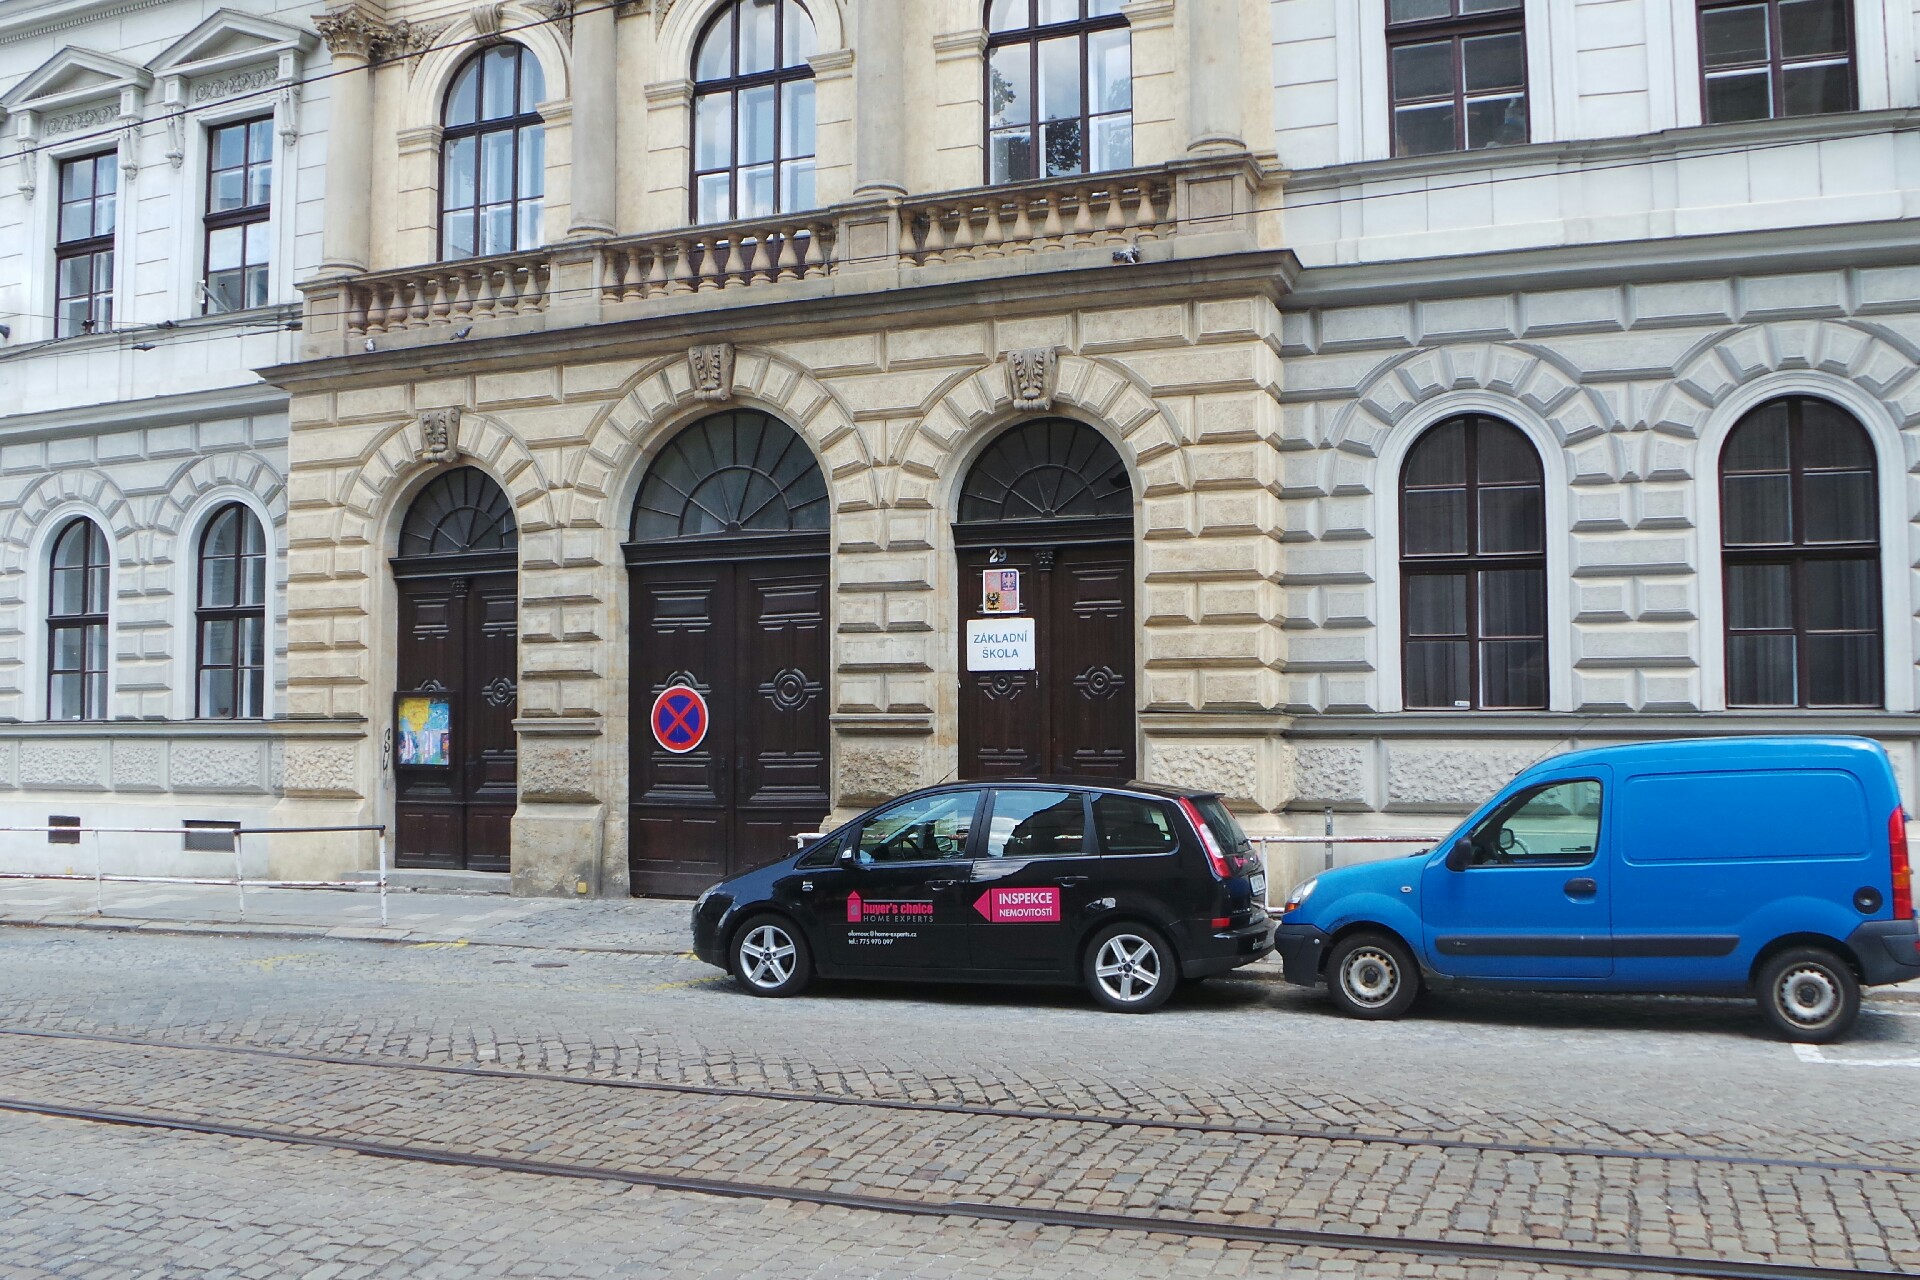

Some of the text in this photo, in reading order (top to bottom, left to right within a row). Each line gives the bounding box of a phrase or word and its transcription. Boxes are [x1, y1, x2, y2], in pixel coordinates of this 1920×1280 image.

[989, 548, 1007, 563] 29
[973, 630, 1028, 644] ZÁKLADNÍ
[982, 647, 1019, 659] ŠKOLA
[999, 892, 1053, 905] INSPEKCE
[863, 903, 933, 915] buyer's choice
[999, 906, 1052, 917] NEMOVITOSTÍ
[894, 915, 934, 923] EXPERTS
